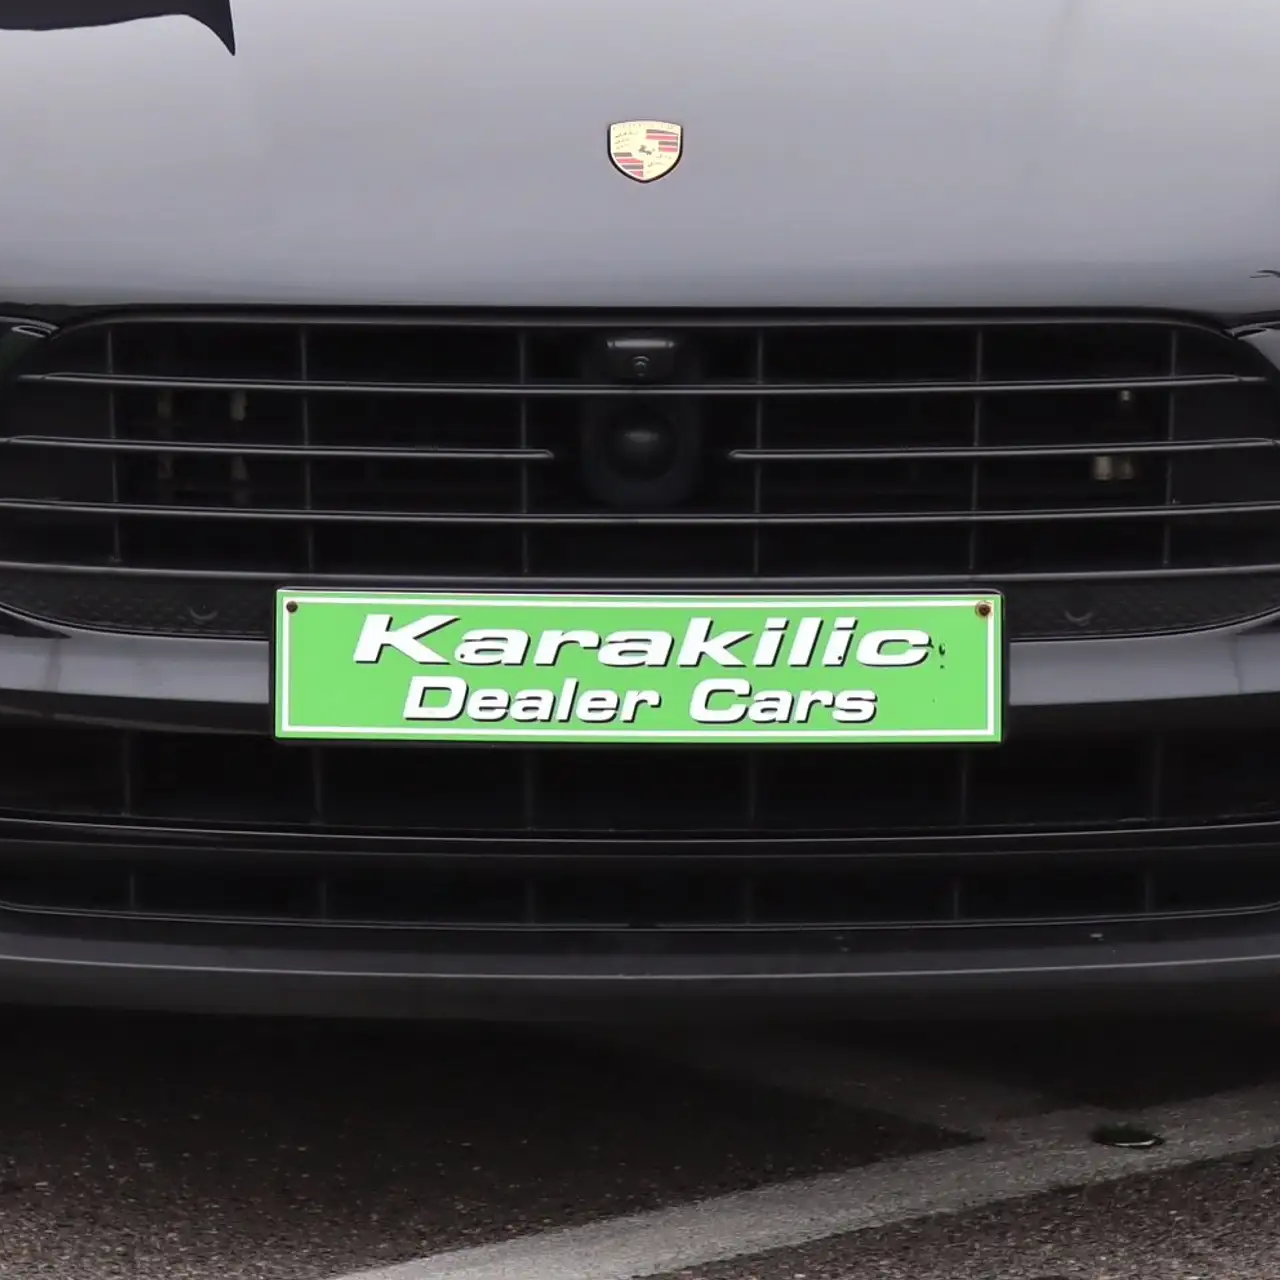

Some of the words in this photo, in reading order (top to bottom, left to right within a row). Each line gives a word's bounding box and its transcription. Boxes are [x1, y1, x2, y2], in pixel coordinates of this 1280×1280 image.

[352, 613, 936, 668] Karakilic
[401, 675, 661, 724] Dealer
[687, 677, 879, 724] Cars
